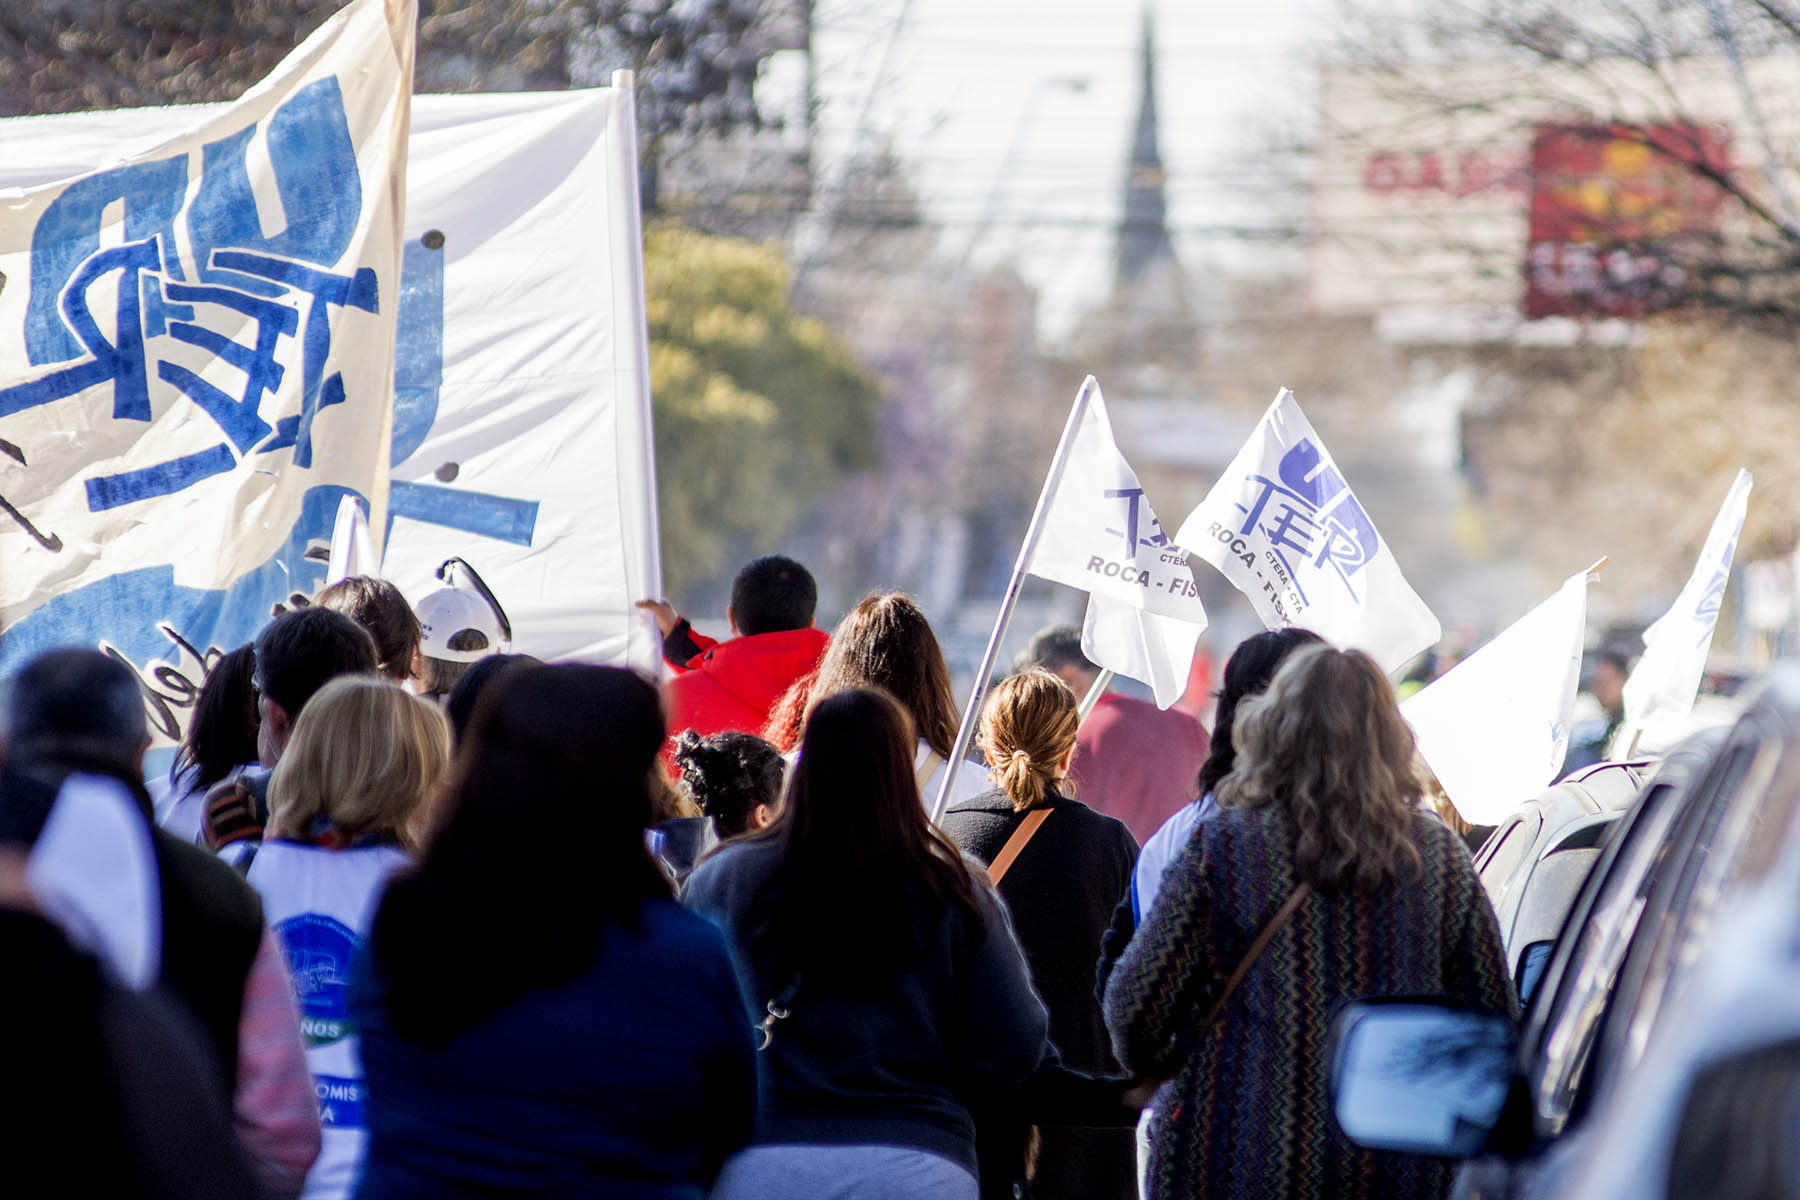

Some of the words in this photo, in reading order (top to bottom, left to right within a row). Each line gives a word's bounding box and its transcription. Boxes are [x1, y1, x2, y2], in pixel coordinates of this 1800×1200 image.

[1208, 521, 1256, 569] ROCA
[1086, 555, 1150, 588] ROCA
[1265, 551, 1288, 585] CTERA
[1289, 592, 1303, 614] CTA
